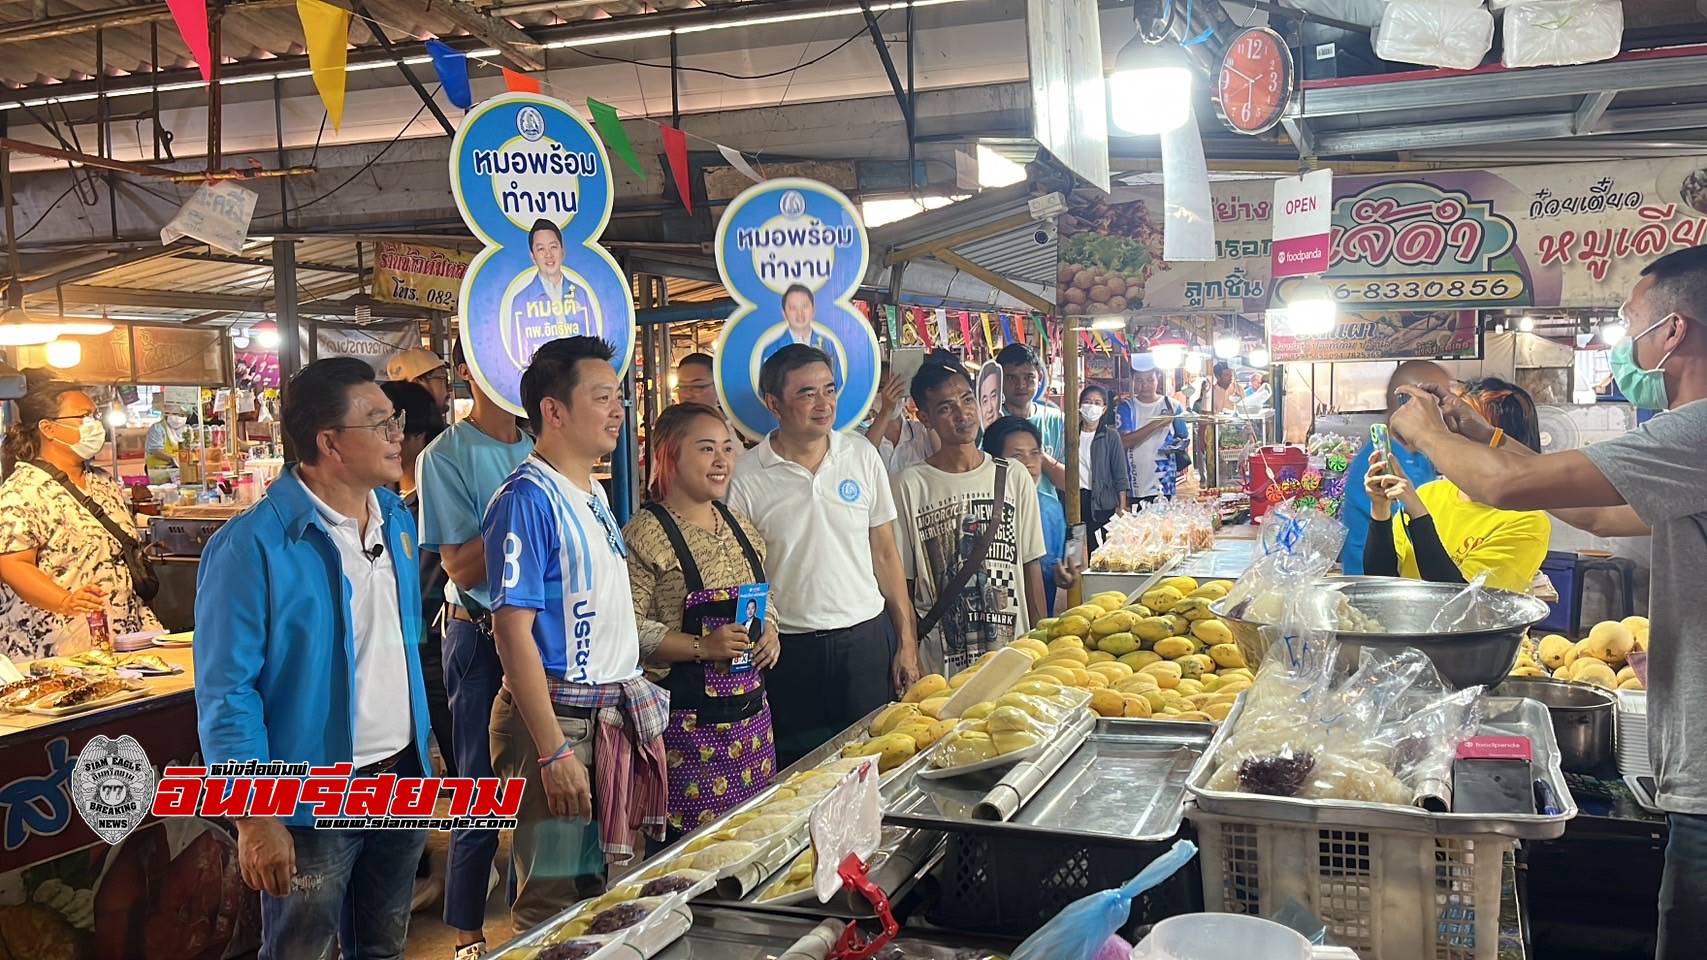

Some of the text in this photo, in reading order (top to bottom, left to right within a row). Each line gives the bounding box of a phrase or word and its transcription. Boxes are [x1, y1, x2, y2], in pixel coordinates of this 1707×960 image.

[1246, 39, 1262, 59] 12
[1221, 69, 1230, 90] 9
[1268, 72, 1278, 92] 3
[1241, 103, 1251, 122] 6
[474, 144, 596, 176] หมอพร้อม
[502, 181, 577, 213] ทำงาน
[1286, 196, 1317, 215] OPEN
[1529, 177, 1643, 218] ก๋วยเตี๋ยว
[737, 219, 853, 250] หมอพร้อม
[760, 252, 831, 280] ทำงาน
[1287, 248, 1322, 262] foodpanda
[391, 276, 419, 301] โทร.
[1184, 267, 1264, 306] ลูกชิ้น
[526, 284, 577, 318] หมอตี๋
[501, 532, 523, 589] 8
